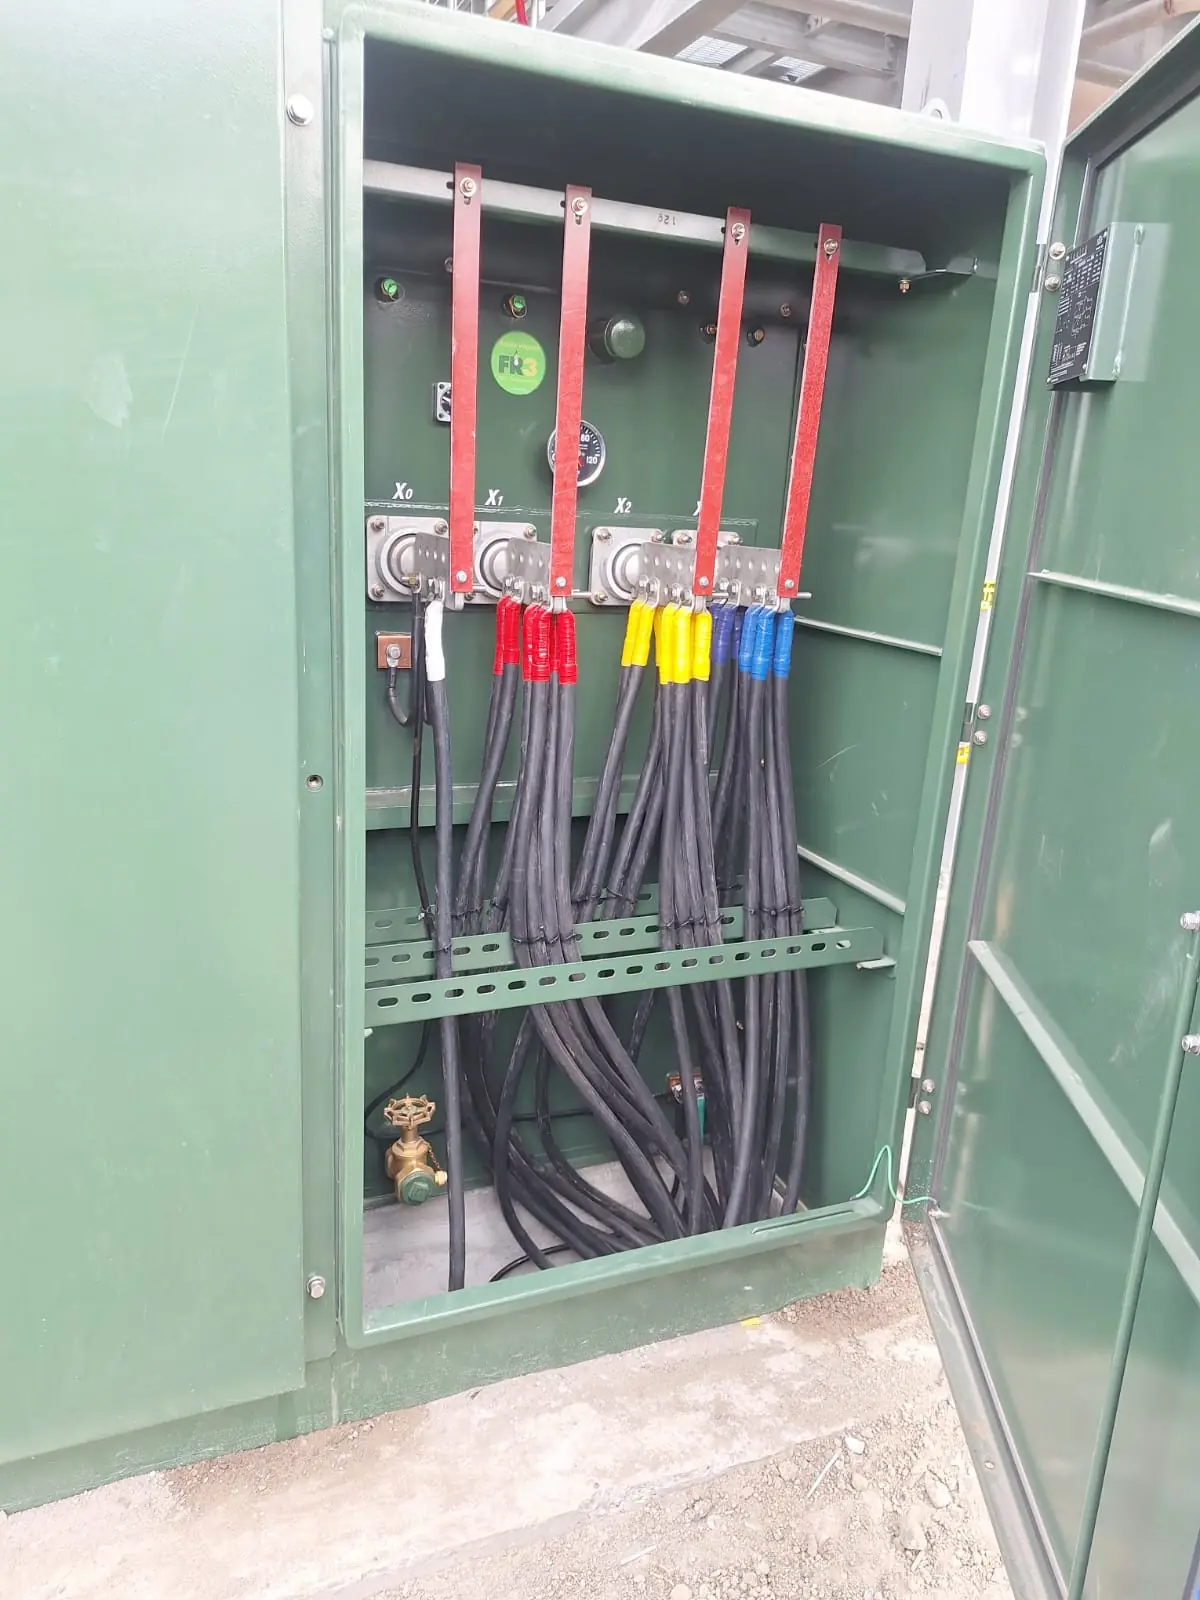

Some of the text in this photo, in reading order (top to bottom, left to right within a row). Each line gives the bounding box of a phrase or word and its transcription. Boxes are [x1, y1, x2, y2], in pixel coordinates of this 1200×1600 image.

[498, 354, 538, 377] FR3
[586, 456, 598, 464] 120
[391, 482, 414, 500] X0
[484, 489, 504, 506] X1
[613, 497, 632, 514] X2
